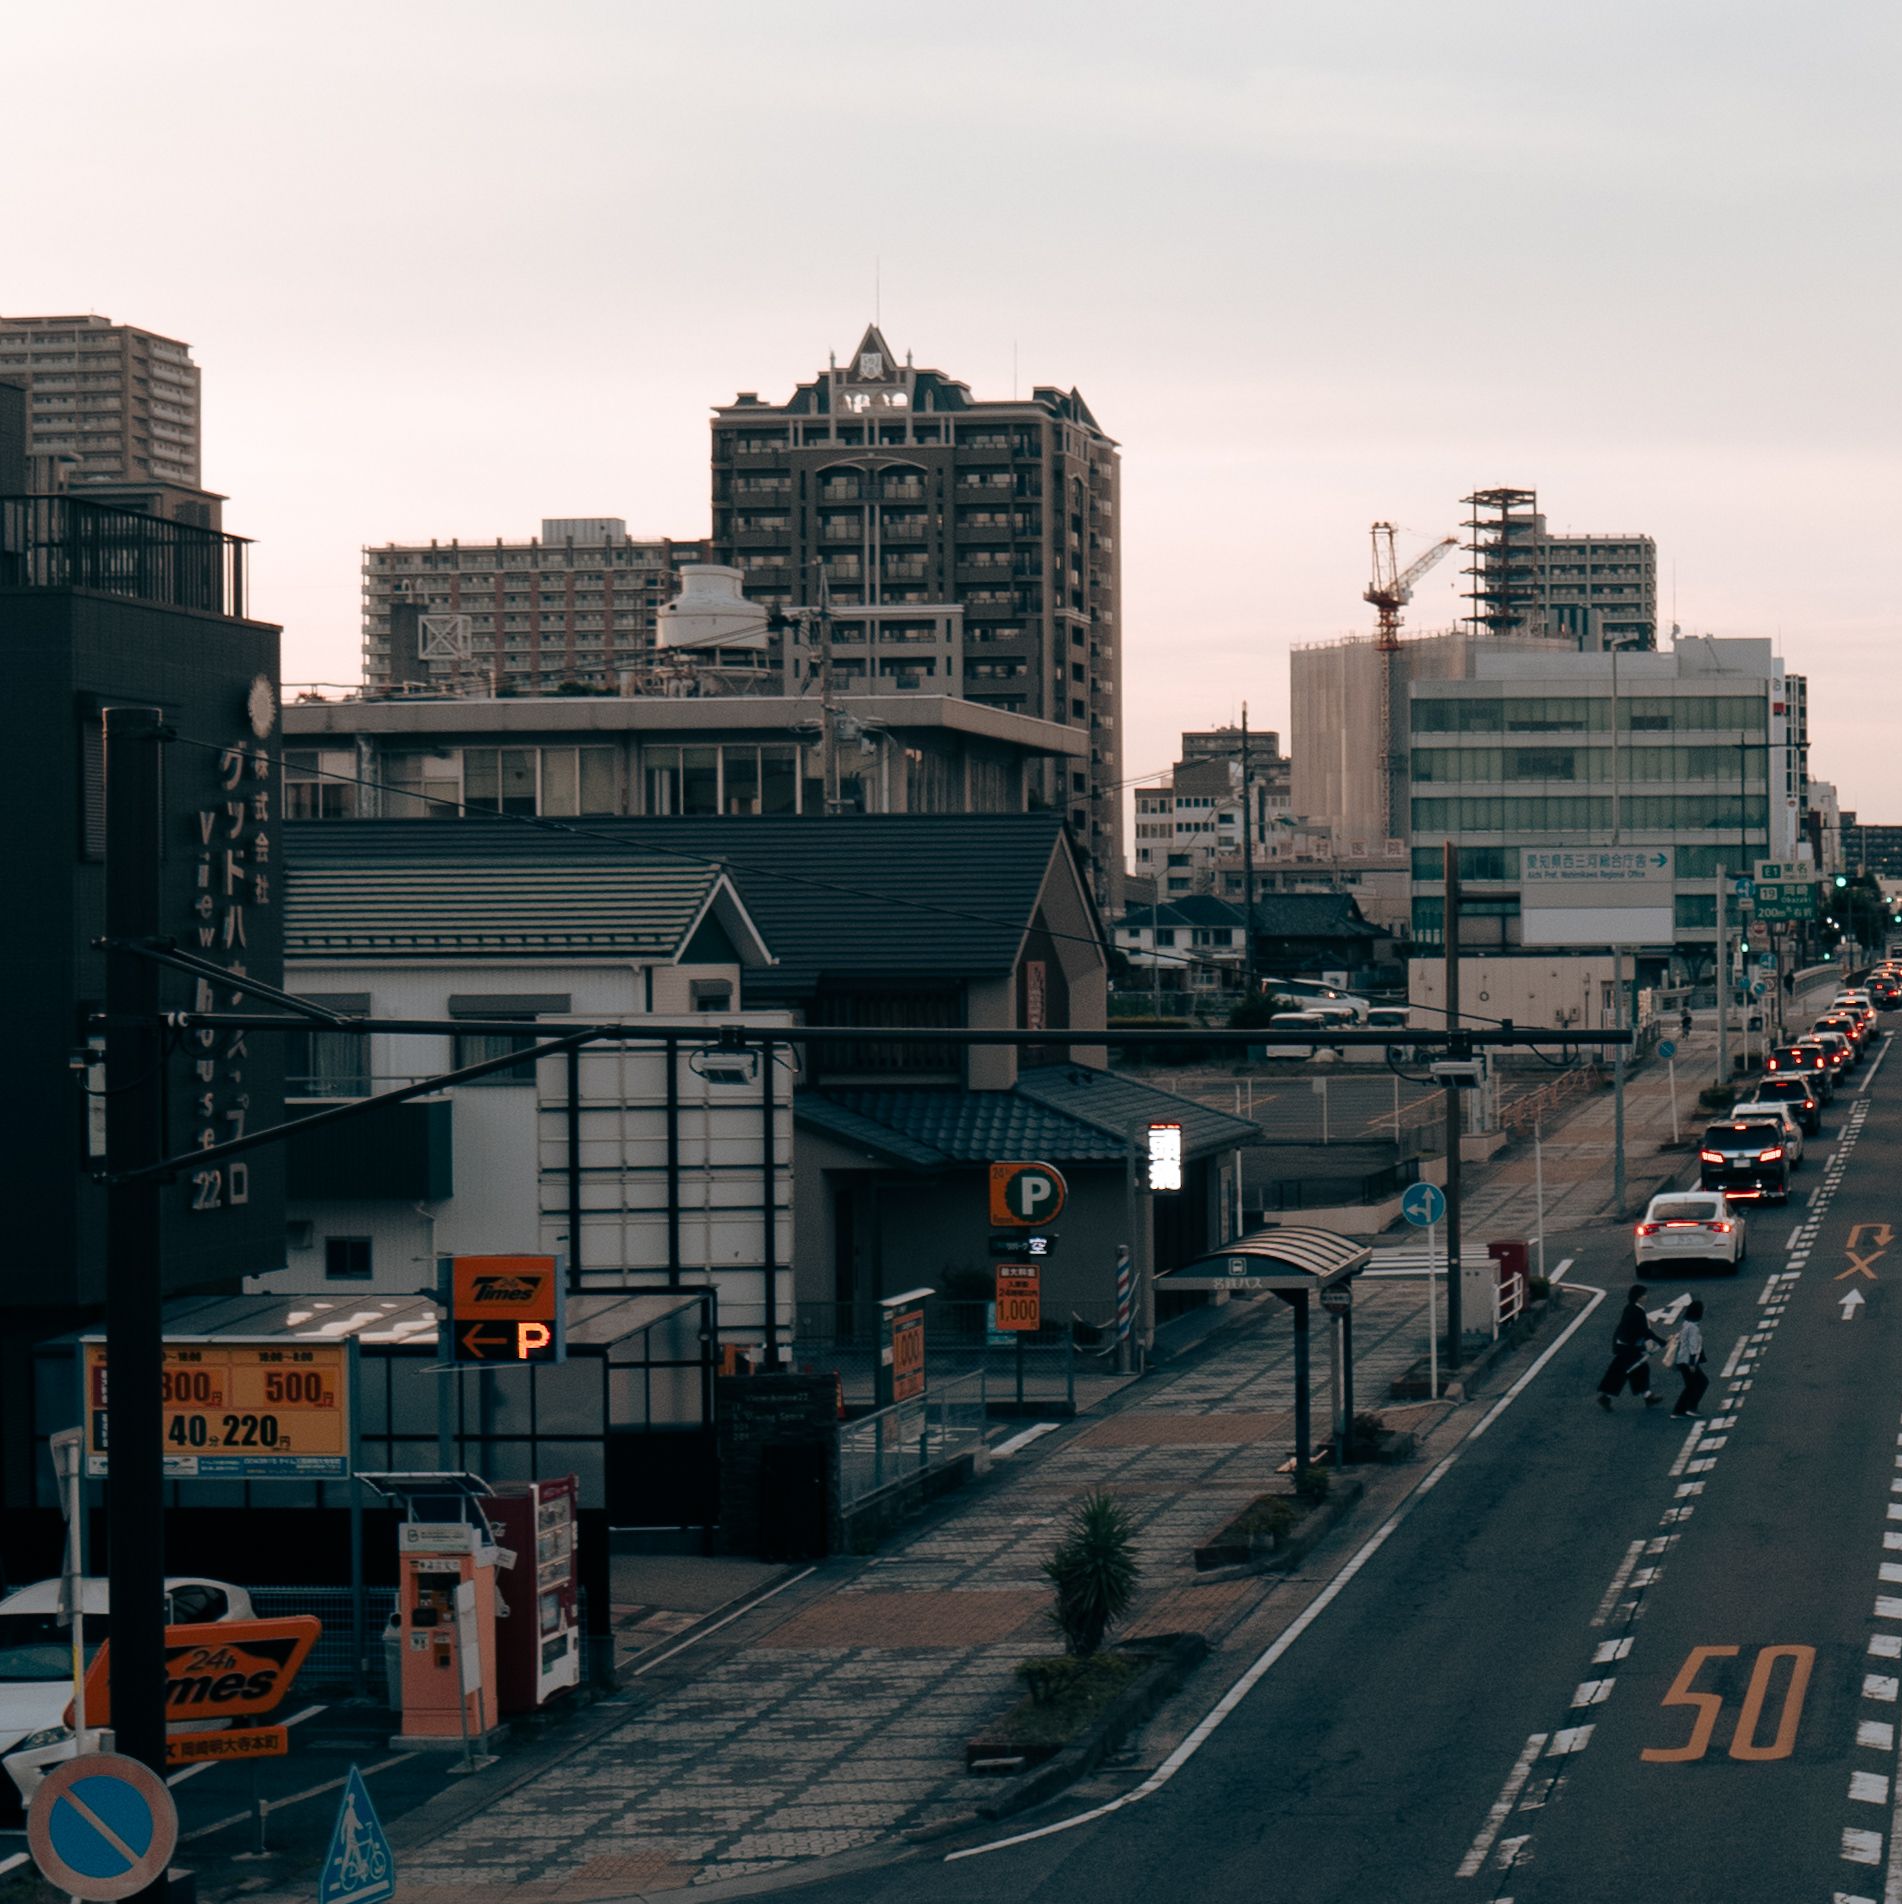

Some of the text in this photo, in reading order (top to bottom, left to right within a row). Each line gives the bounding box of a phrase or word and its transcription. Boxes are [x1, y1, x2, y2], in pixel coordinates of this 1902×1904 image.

[254, 749, 270, 905] 株式会社
[1526, 853, 1647, 869] 愛知県西三河総合庁舎
[1762, 889, 1775, 898] 19
[1020, 1176, 1051, 1216] P
[473, 1284, 535, 1303] Times
[998, 1299, 1038, 1322] 1,000
[516, 1321, 552, 1360] P
[186, 1649, 236, 1671] 24h
[165, 1669, 279, 1704] mes
[1640, 1645, 1817, 1762] 50
